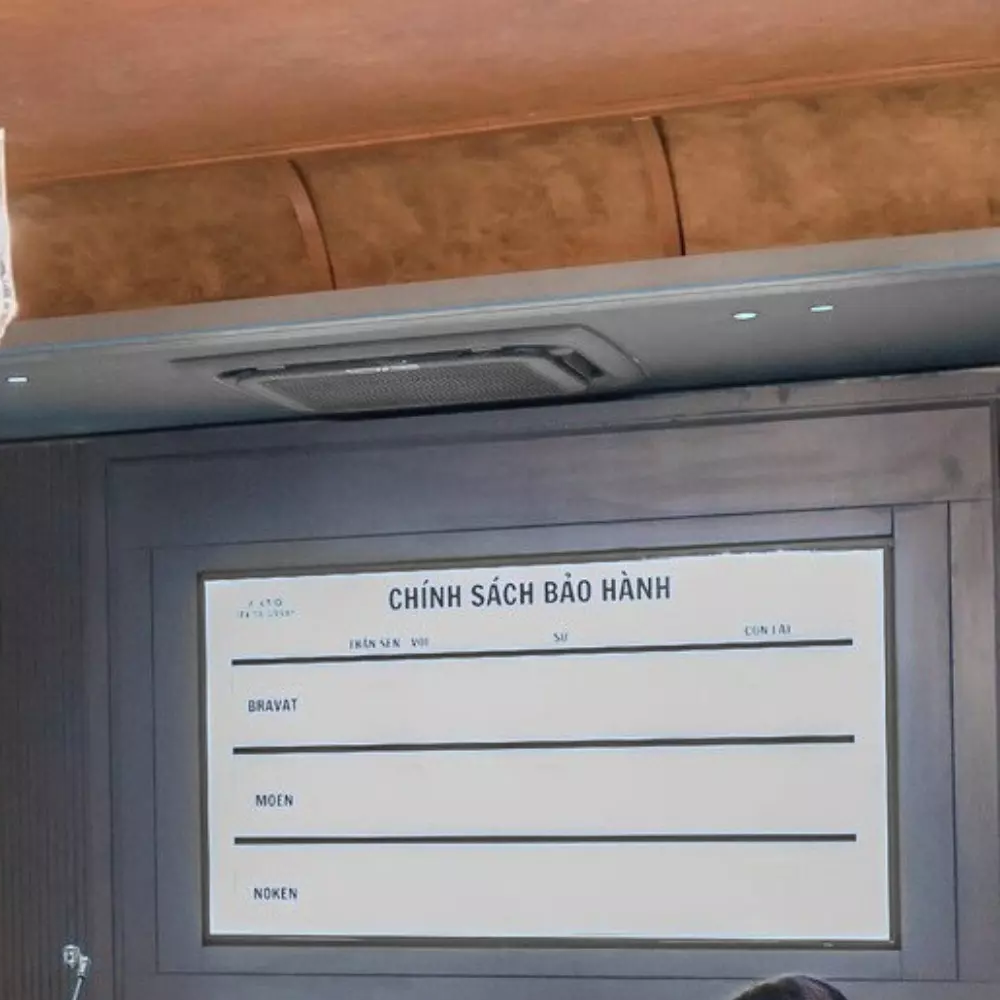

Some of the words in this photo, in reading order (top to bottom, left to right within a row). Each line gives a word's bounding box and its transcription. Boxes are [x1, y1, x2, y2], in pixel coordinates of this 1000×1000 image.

[388, 579, 462, 610] CHÍNH
[470, 576, 534, 607] SÁCH
[544, 572, 592, 604] BẢO
[602, 570, 671, 602] HÀNH
[248, 699, 298, 713] BRAVAT
[255, 794, 294, 807] MOEN
[254, 887, 298, 900] NOKEN
